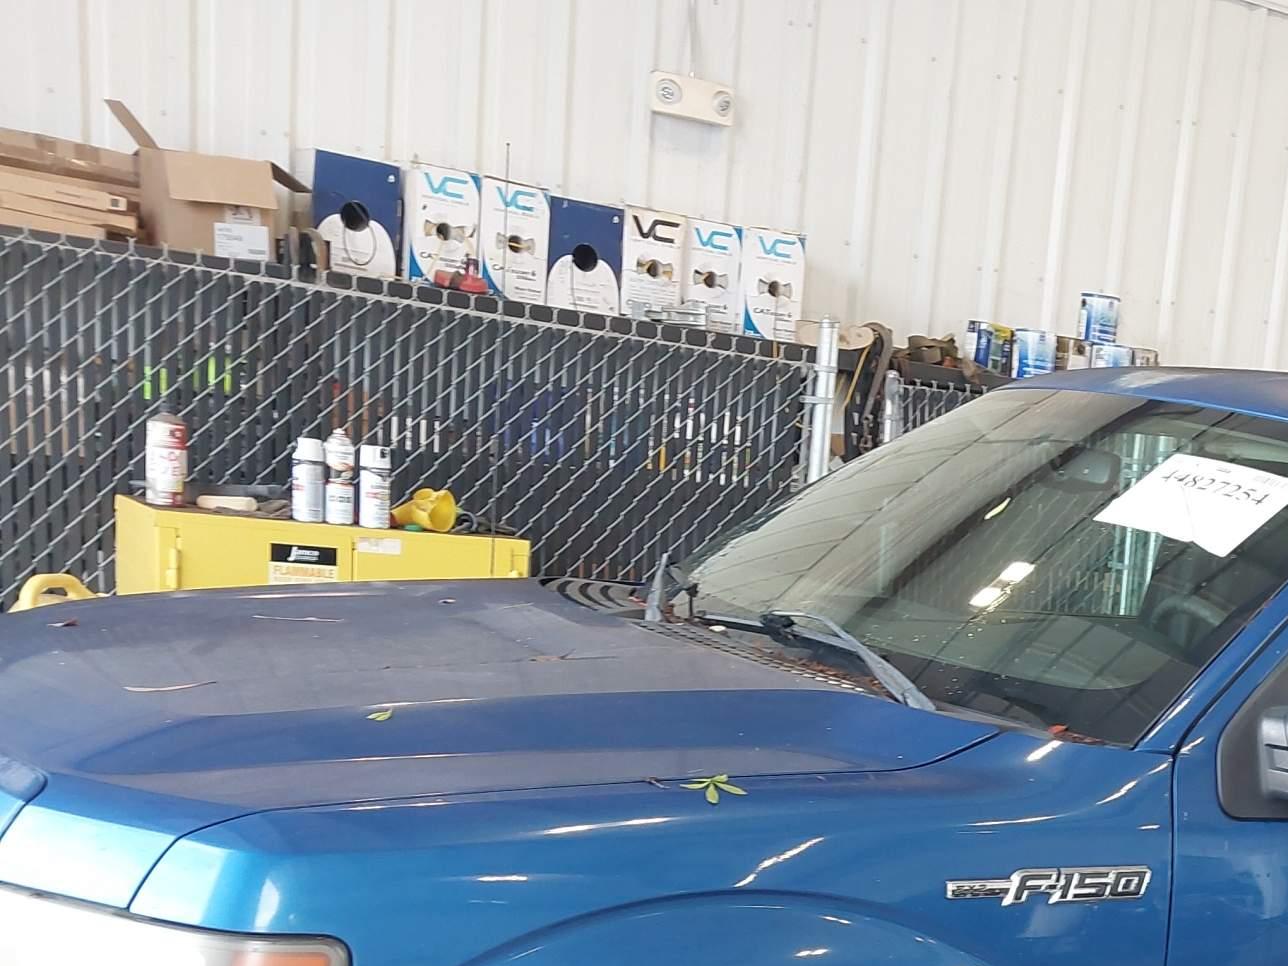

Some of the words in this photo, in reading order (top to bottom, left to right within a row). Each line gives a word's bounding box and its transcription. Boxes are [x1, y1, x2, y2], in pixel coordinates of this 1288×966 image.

[424, 172, 469, 200] VC
[496, 186, 537, 213] VC
[632, 214, 680, 244] VC
[695, 227, 733, 251] VC
[758, 236, 798, 259] VC
